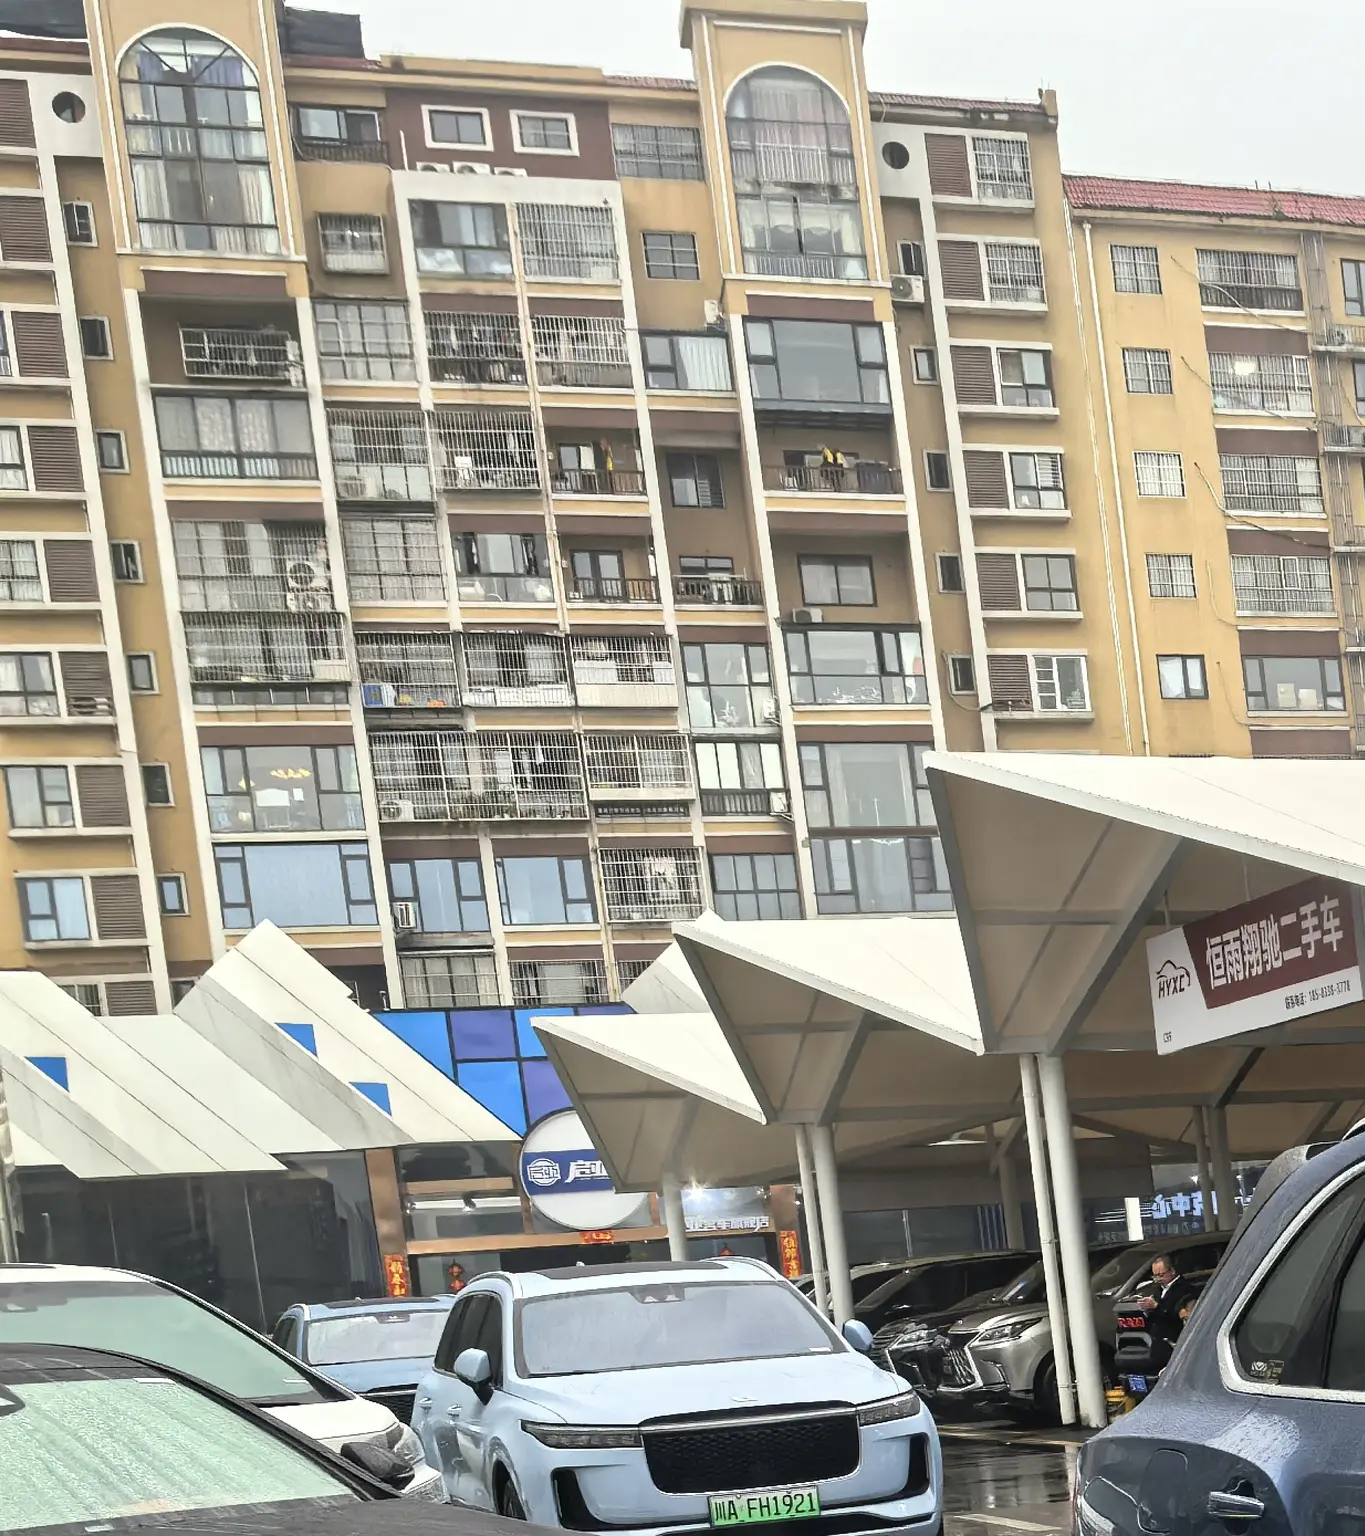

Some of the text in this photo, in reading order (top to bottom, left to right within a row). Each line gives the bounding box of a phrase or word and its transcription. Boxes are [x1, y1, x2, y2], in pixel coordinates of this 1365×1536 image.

[1206, 895, 1343, 990] 恒雨翔驰二手车
